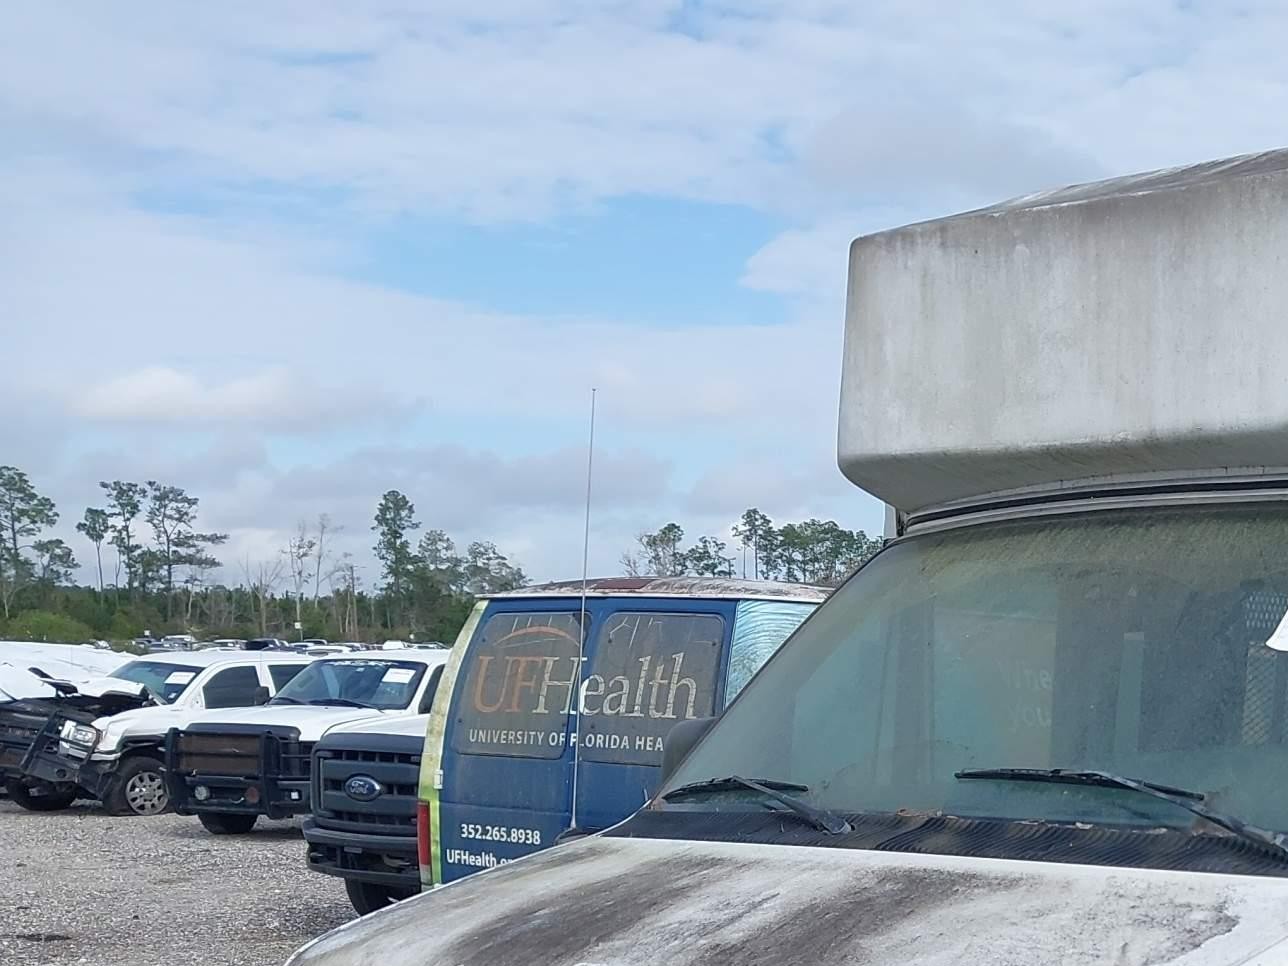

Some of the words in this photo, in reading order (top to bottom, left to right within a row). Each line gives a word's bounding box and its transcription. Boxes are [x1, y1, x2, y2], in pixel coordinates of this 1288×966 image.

[469, 728, 545, 746] UNIVERSITY
[548, 732, 566, 747] OF
[569, 733, 630, 750] FORIDA
[634, 736, 664, 752] HEA
[460, 824, 541, 845] 352.265.8938
